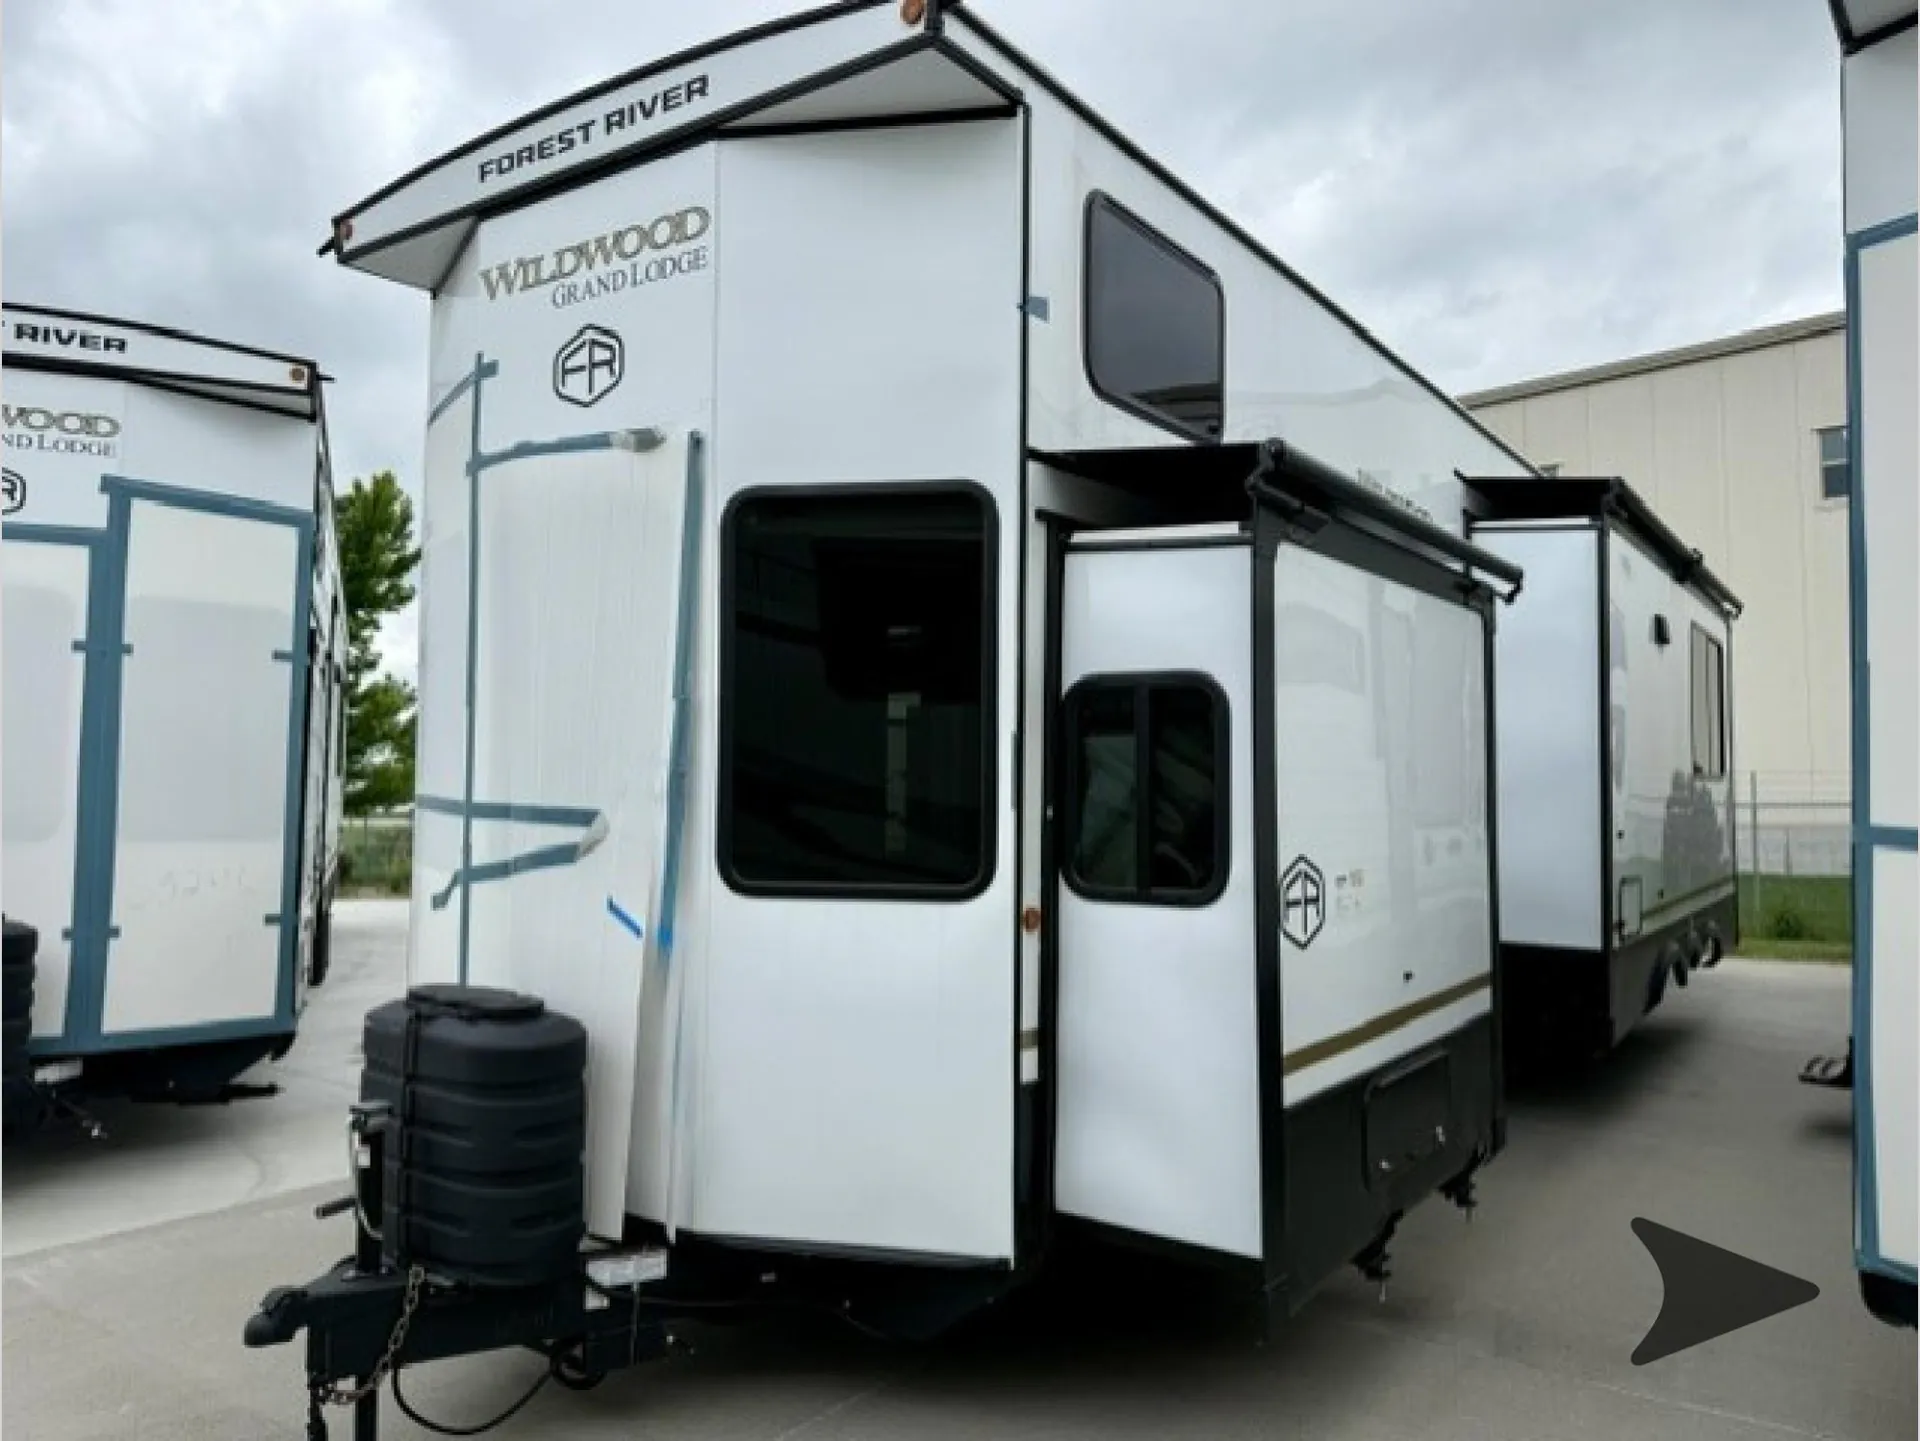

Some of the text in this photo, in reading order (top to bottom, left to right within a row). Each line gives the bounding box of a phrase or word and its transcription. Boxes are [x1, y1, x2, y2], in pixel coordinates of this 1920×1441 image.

[477, 74, 710, 183] FOREST RIVER
[479, 206, 712, 301] WILDWOOD
[552, 245, 709, 309] GRAND LODGE
[13, 322, 128, 354] RIVER
